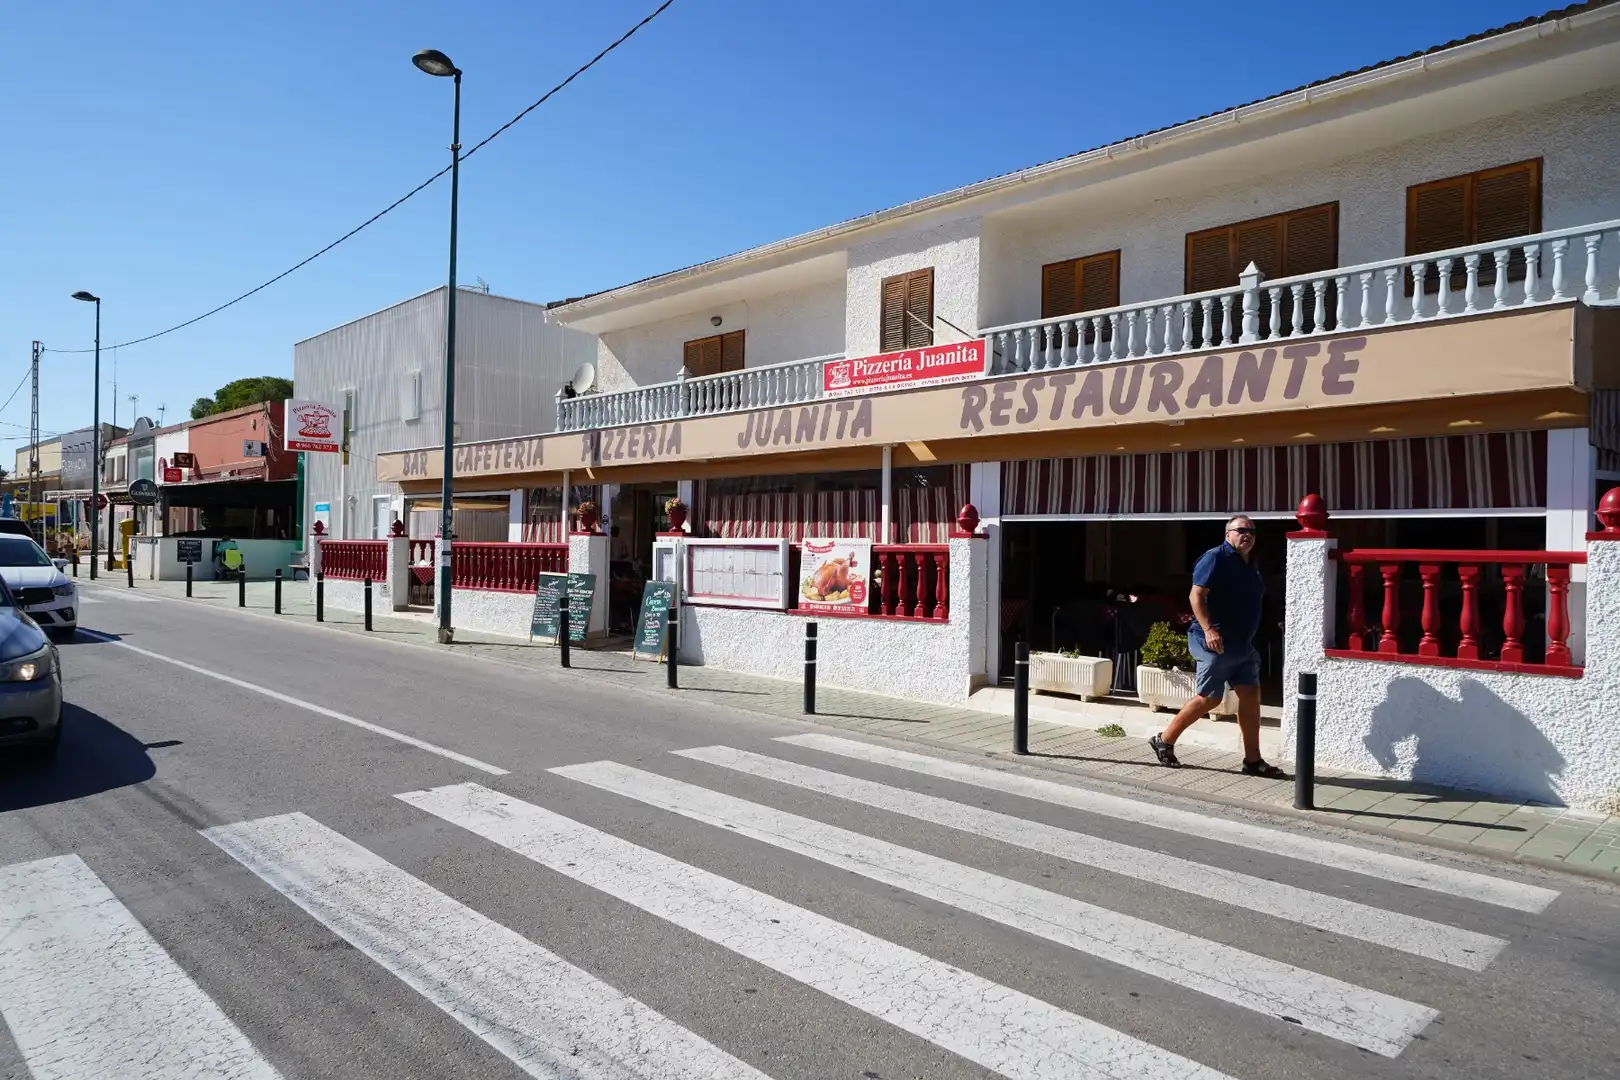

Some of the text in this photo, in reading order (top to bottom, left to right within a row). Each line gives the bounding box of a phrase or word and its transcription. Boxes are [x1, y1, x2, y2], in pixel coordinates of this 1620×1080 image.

[853, 345, 978, 377] Pizzería Juanita
[402, 336, 1367, 477] BAR CAFETERIA PIZZERIA JUANITA RESTAURANTE
[130, 489, 157, 497] GUINNESS
